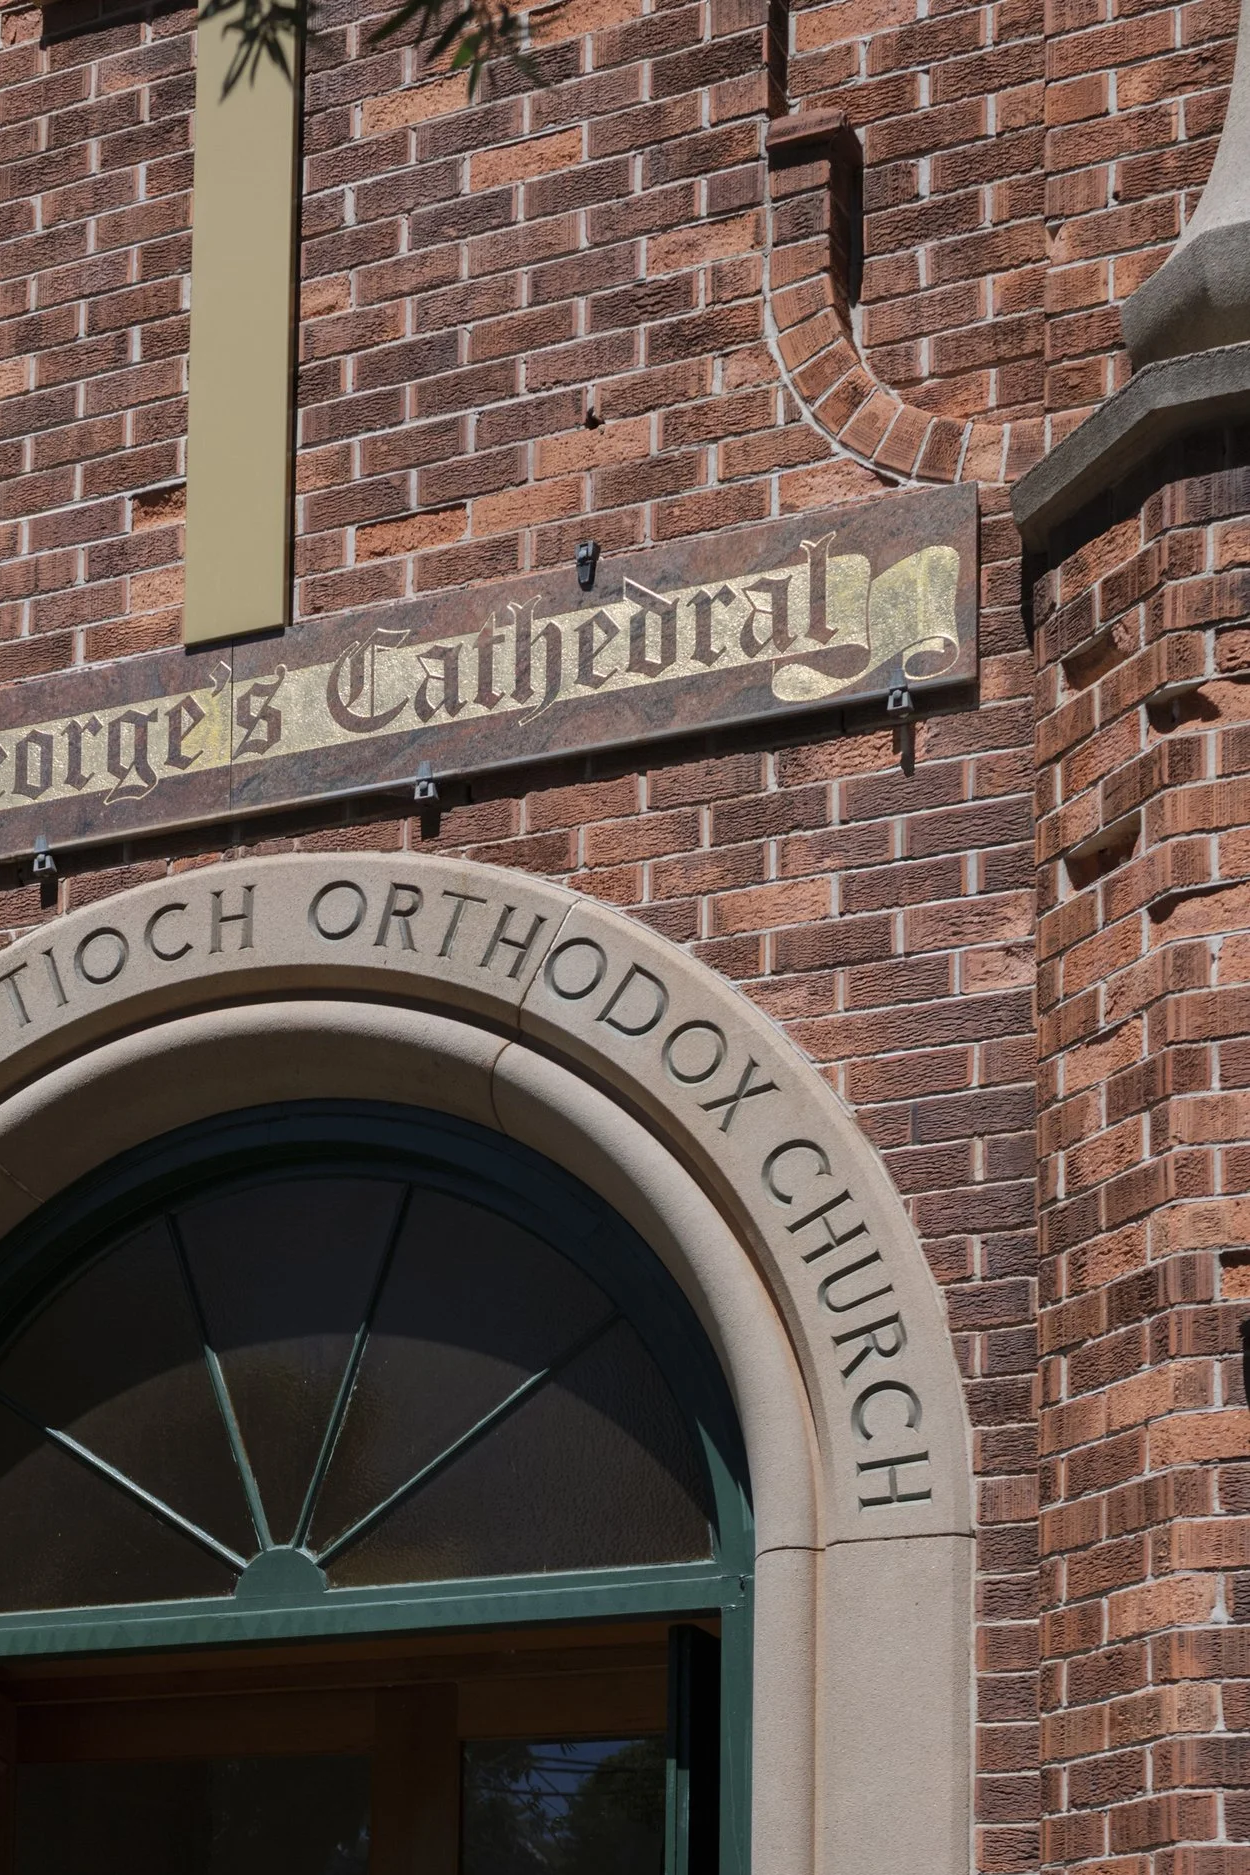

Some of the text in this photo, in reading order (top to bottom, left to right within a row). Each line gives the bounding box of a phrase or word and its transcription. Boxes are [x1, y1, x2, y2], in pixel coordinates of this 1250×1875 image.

[326, 531, 840, 733] Cathedral
[307, 879, 781, 1134] ORTHODOX
[761, 1137, 933, 1511] CHURCH
